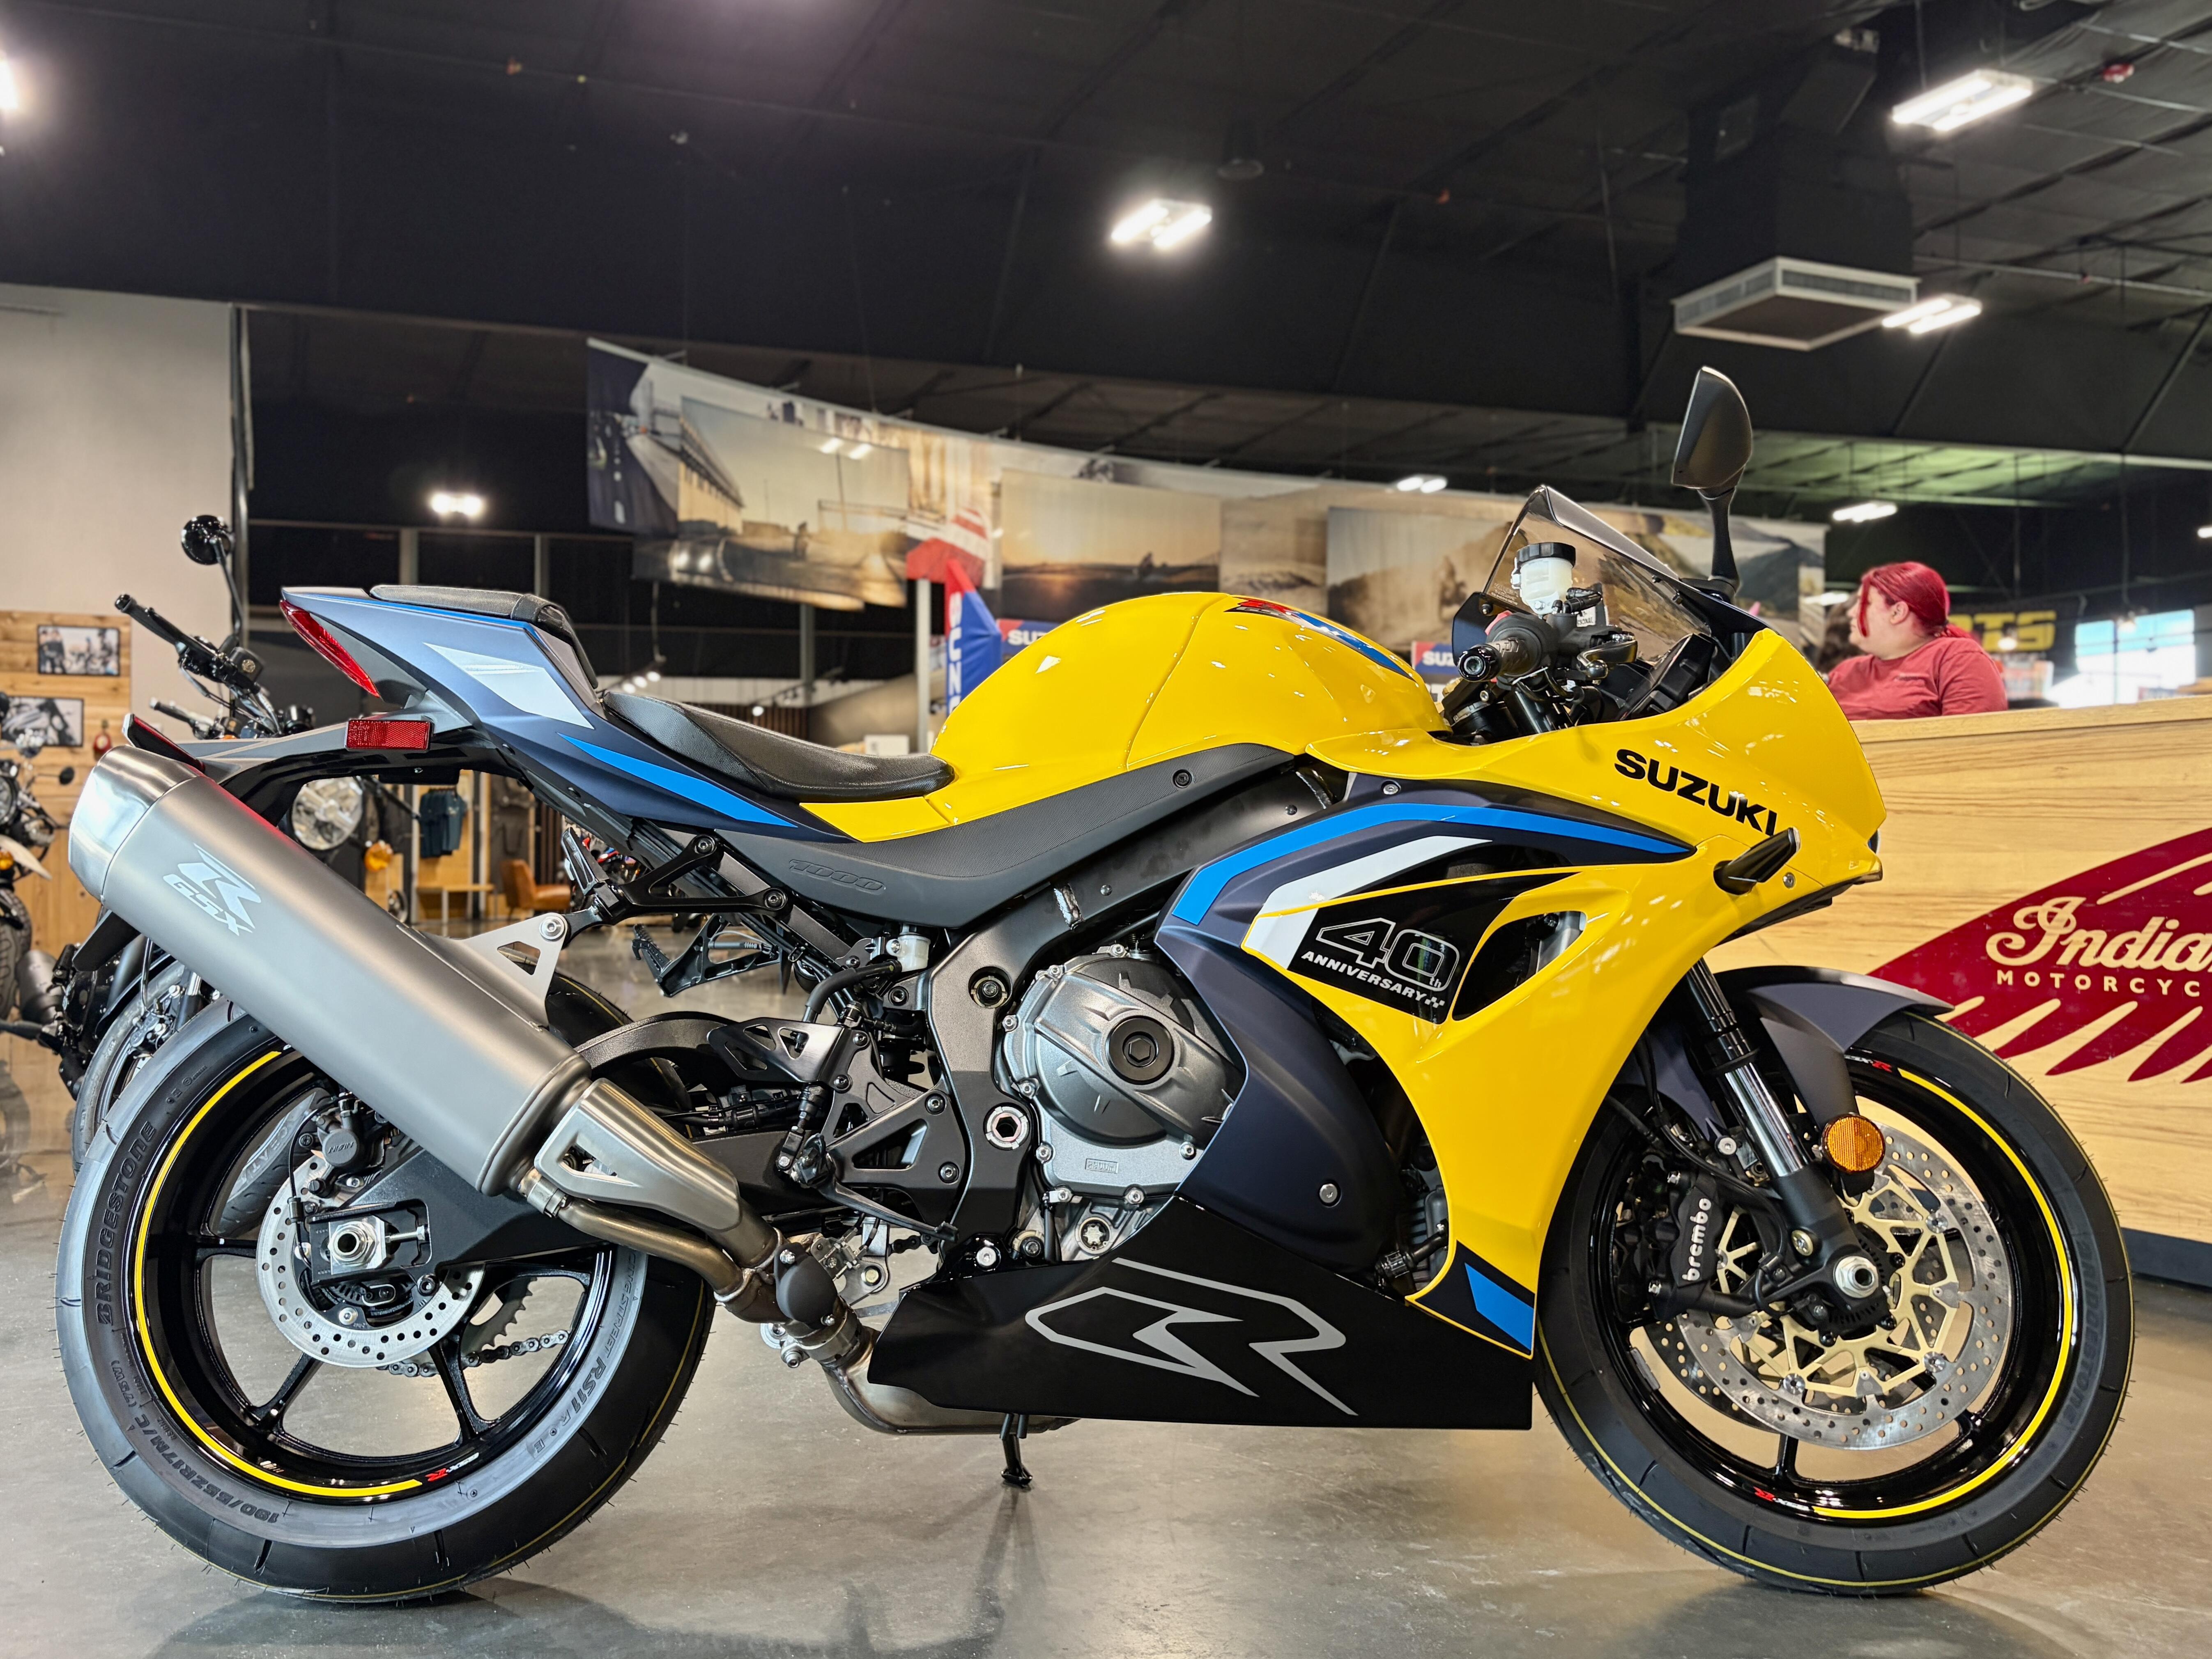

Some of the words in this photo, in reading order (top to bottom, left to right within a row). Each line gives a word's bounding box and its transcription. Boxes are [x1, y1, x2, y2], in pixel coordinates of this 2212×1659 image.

[1008, 630, 1048, 645] SU
[1614, 749, 1777, 836] SUZUKI
[163, 874, 253, 936] GSX
[789, 859, 885, 892] 1000
[1315, 917, 1460, 991] 40
[1986, 896, 2212, 973] India
[1301, 951, 1427, 1002] ANNIVERSARY
[95, 1120, 156, 1326] BRIDGESTONE
[1682, 1198, 1712, 1281] brembo
[571, 1356, 607, 1414] RS11
